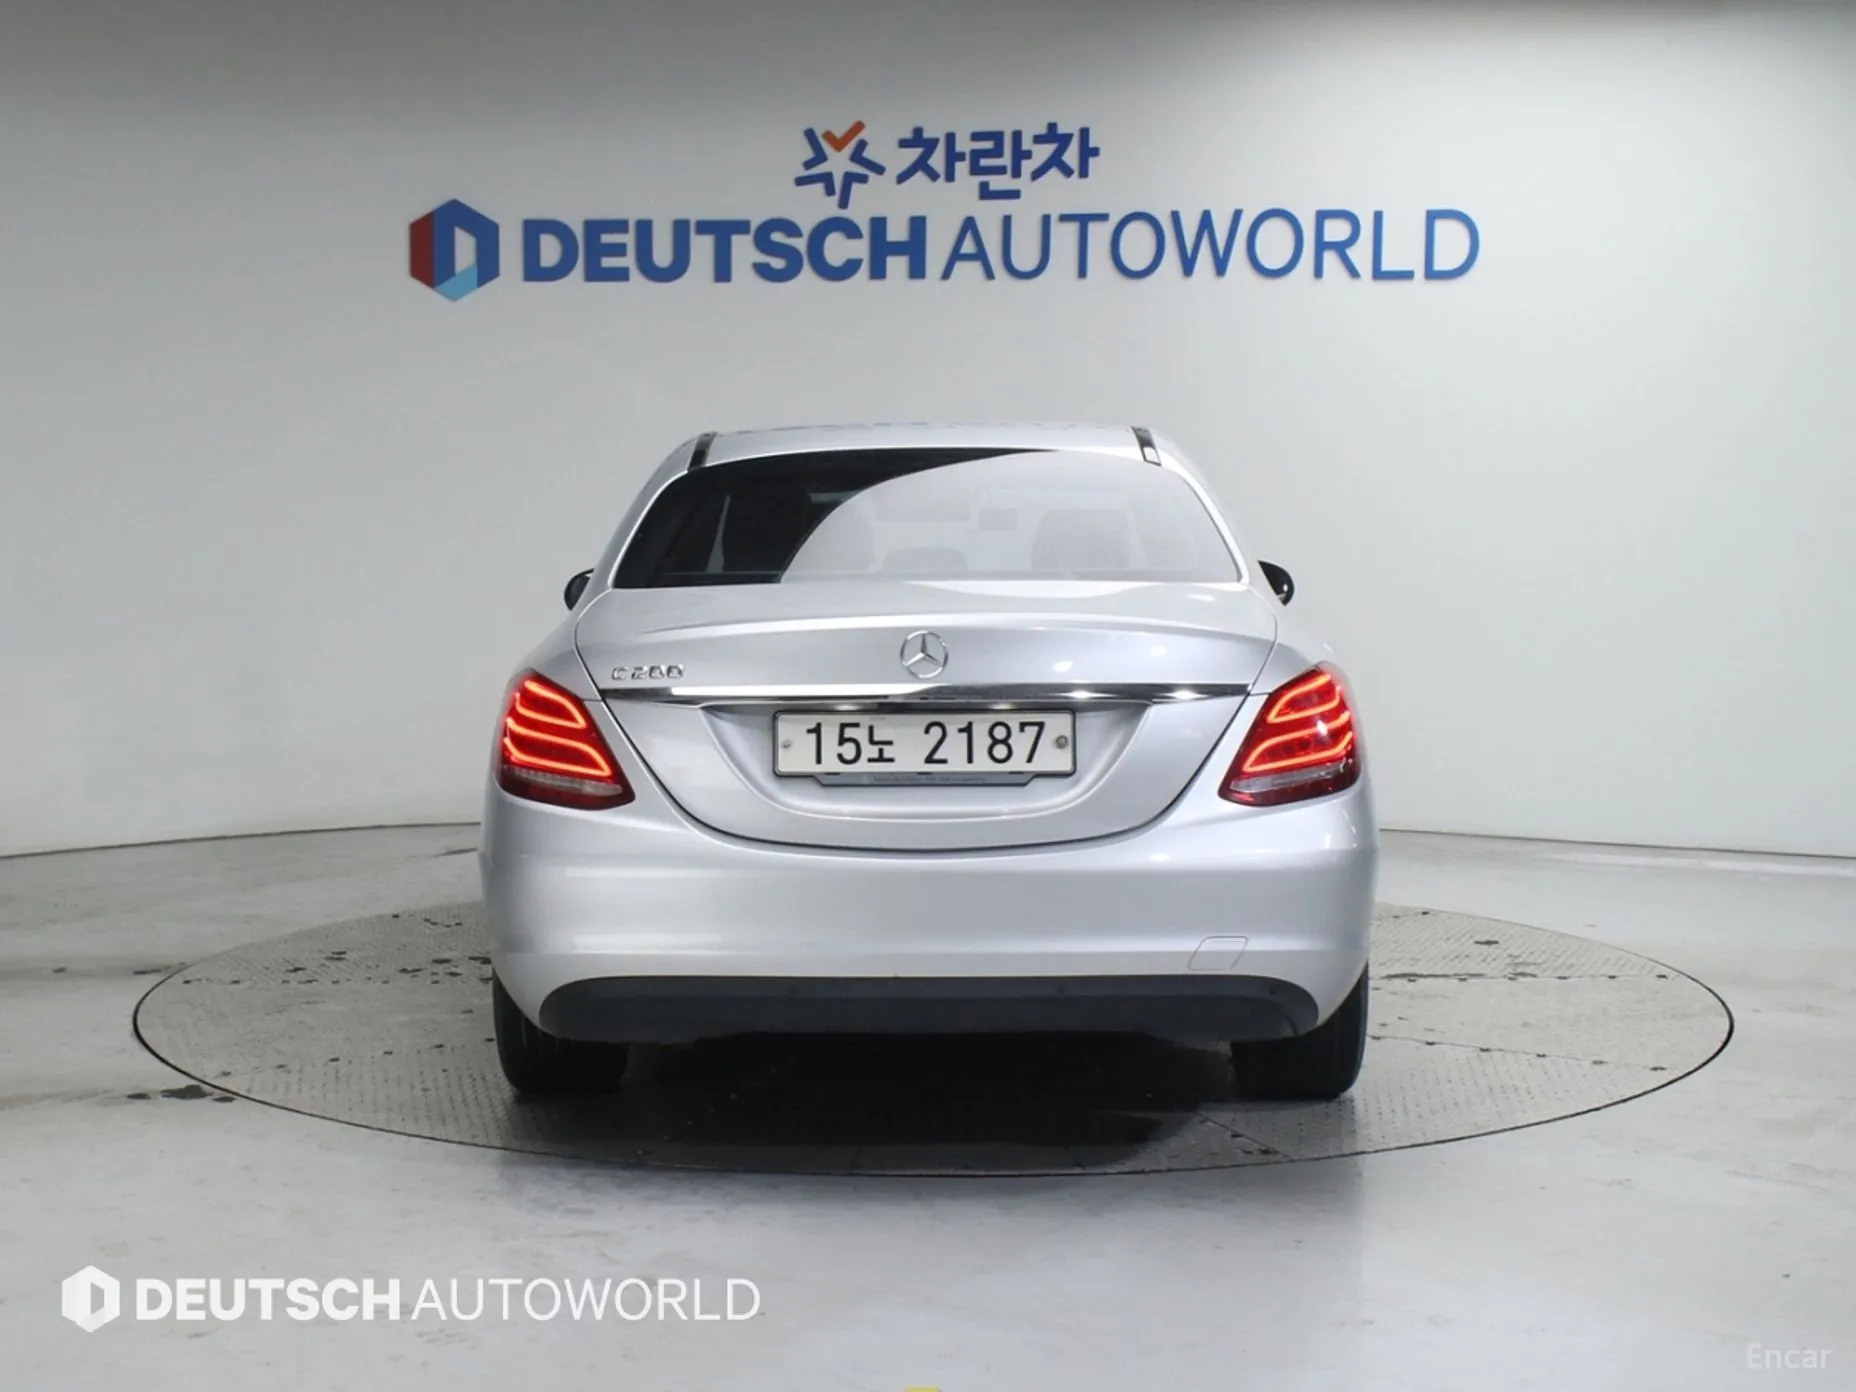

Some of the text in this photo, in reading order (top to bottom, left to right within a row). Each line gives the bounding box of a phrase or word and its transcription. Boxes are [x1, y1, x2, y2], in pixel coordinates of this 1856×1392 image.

[897, 121, 1100, 200] 차란차
[521, 208, 1481, 283] DEUTSCH AUTOWORLD
[806, 721, 1046, 765] 15노 2187
